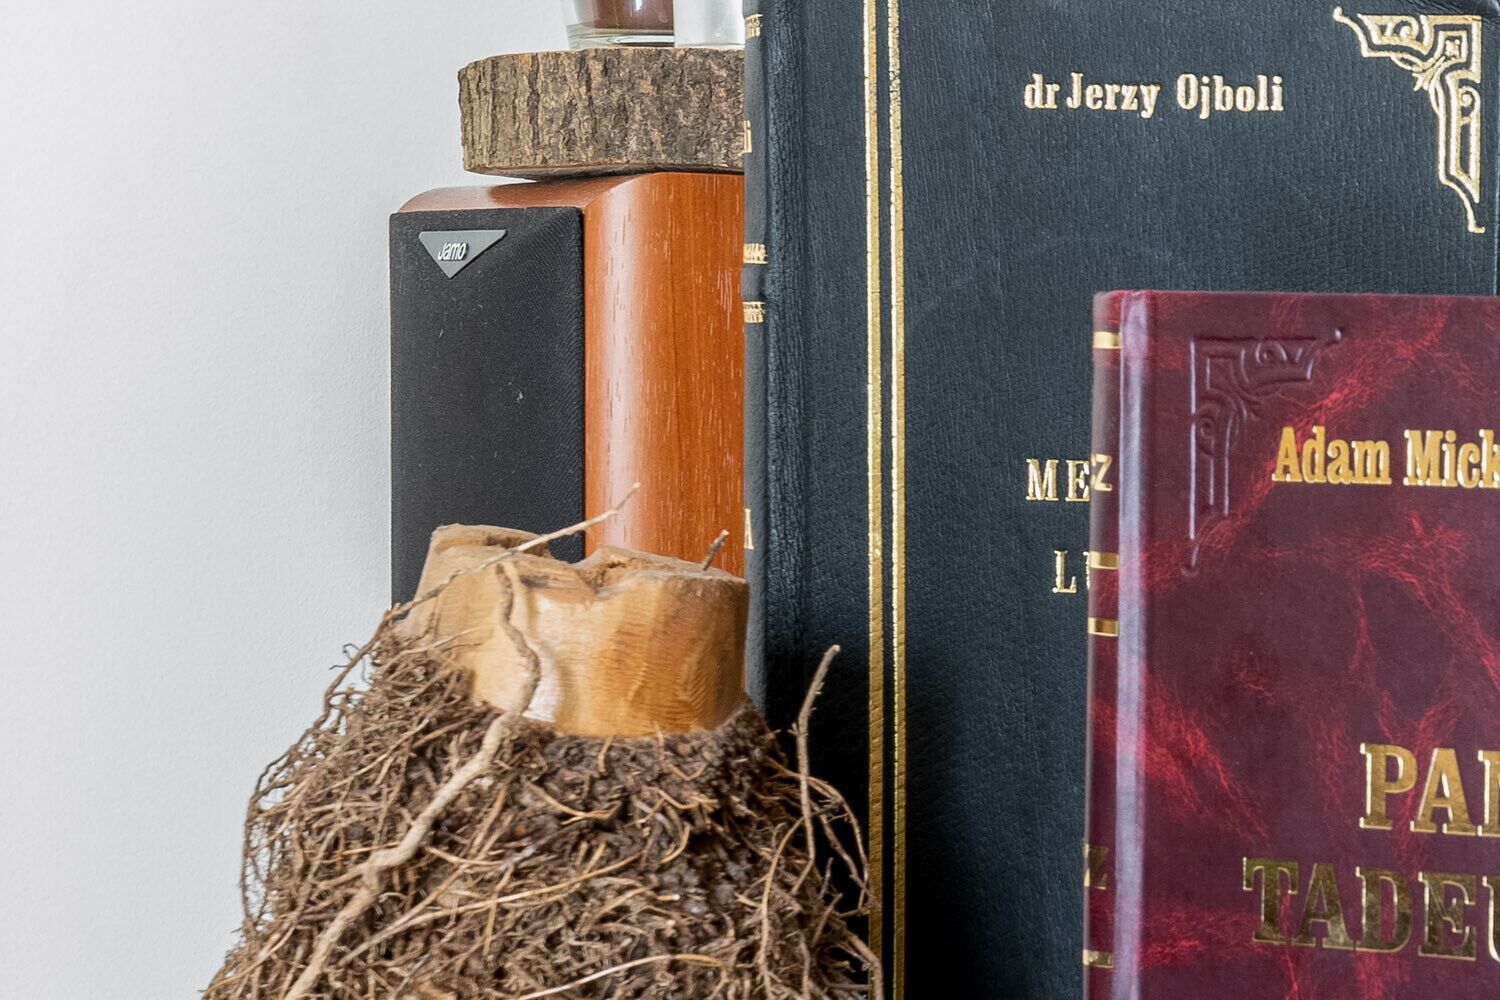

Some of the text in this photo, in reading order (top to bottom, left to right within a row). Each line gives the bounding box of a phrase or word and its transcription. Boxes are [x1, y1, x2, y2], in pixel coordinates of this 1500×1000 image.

[1023, 71, 1285, 120] dr Jerzy Ojboli
[437, 242, 467, 260] Jamo
[1271, 425, 1392, 485] Adam
